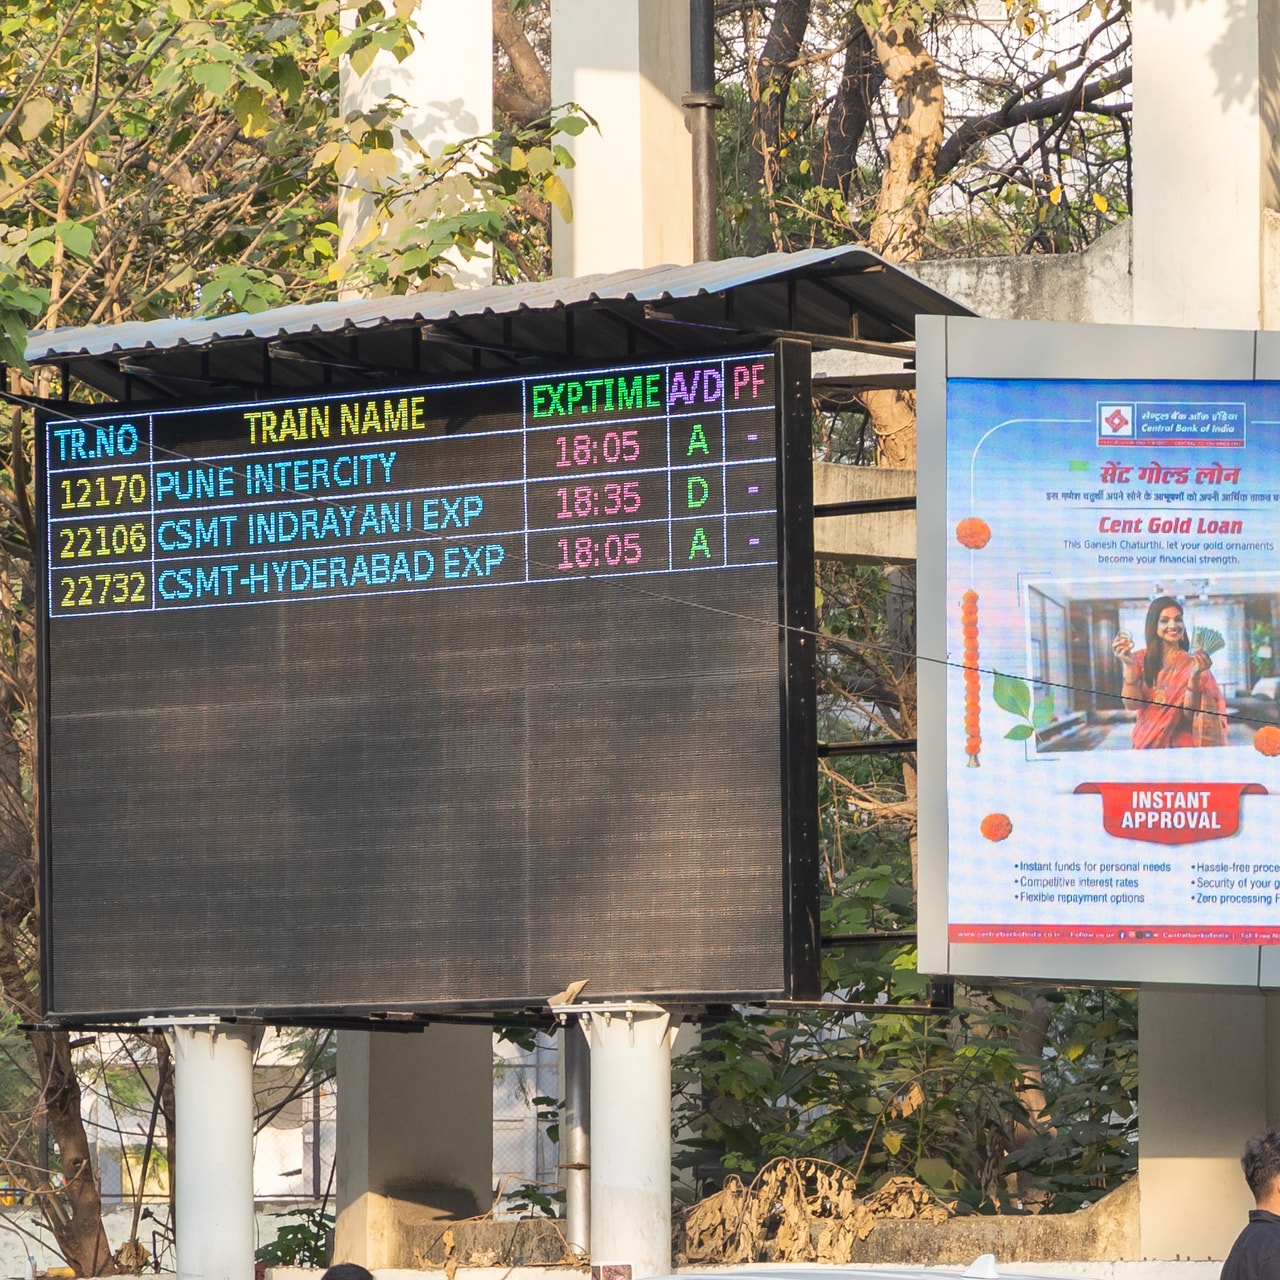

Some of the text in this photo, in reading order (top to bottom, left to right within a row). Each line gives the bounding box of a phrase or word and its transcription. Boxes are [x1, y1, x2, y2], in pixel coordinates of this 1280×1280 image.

[533, 374, 660, 417] EXP.TIME
[669, 368, 722, 406] A/D
[734, 364, 764, 399] PF
[244, 397, 425, 444] TRAIN NAME
[1141, 423, 1234, 432] Central Bank of India
[54, 424, 138, 460] TR.NO
[556, 431, 640, 467] 18:05
[687, 424, 709, 456] A
[157, 452, 396, 501] PUNE INTERCITY
[1100, 461, 1241, 484] सेंट गोल्ड लोन
[60, 474, 146, 509] 12170
[557, 482, 641, 519] 18:35
[688, 476, 708, 508] D
[158, 495, 484, 550] CSMT INDRAYANI EXP
[1098, 517, 1243, 534] Cent Gold Loan
[60, 523, 146, 558] 22106
[558, 533, 642, 570] 18:05
[689, 527, 711, 560] A
[1063, 540, 1081, 550] This
[1084, 540, 1117, 550] Ganesh
[1166, 540, 1178, 550] let
[1181, 542, 1200, 552] your
[1203, 540, 1223, 552] gold
[1225, 541, 1274, 550] ornaments
[158, 544, 504, 599] CSMT-HYDERABAD EXP
[1098, 555, 1134, 564] become
[1136, 556, 1156, 566] your
[1159, 555, 1197, 564] financial
[61, 572, 145, 607] 22732
[1132, 791, 1210, 808] INSTANT
[1121, 811, 1220, 828] APPROVAL
[1020, 861, 1171, 874] Instant funds for personal needs
[1020, 876, 1139, 889] Competitive interest rates
[1197, 862, 1249, 872] Hassle-free
[1020, 892, 1145, 905] Flexible repayment options
[1197, 877, 1235, 889] Security
[1238, 878, 1247, 888] of
[1250, 880, 1271, 890] your
[1197, 893, 1217, 903] Zero
[1220, 893, 1272, 905] processing
